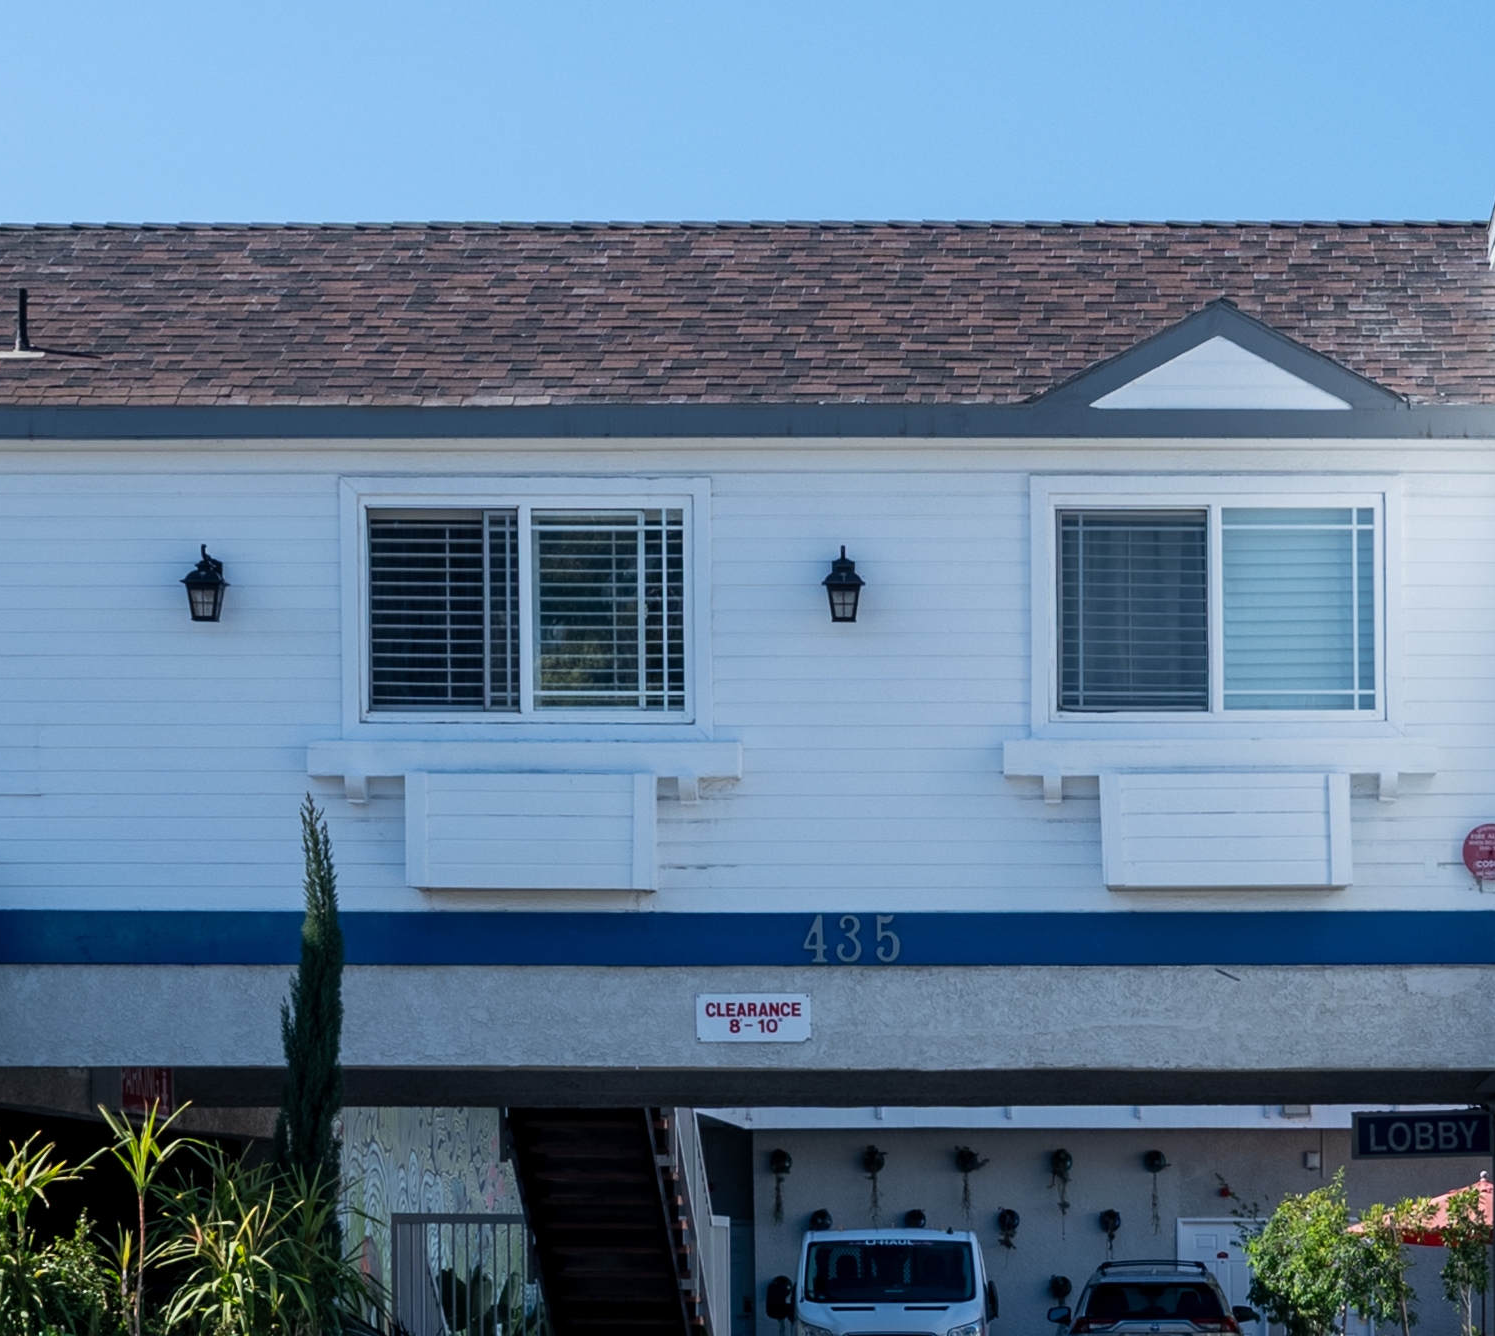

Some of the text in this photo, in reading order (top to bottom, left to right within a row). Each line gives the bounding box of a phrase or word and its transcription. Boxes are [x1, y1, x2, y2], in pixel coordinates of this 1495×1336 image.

[803, 914, 901, 962] 435
[705, 1002, 802, 1018] CLEARANCE
[1369, 1121, 1479, 1152] LOBBY
